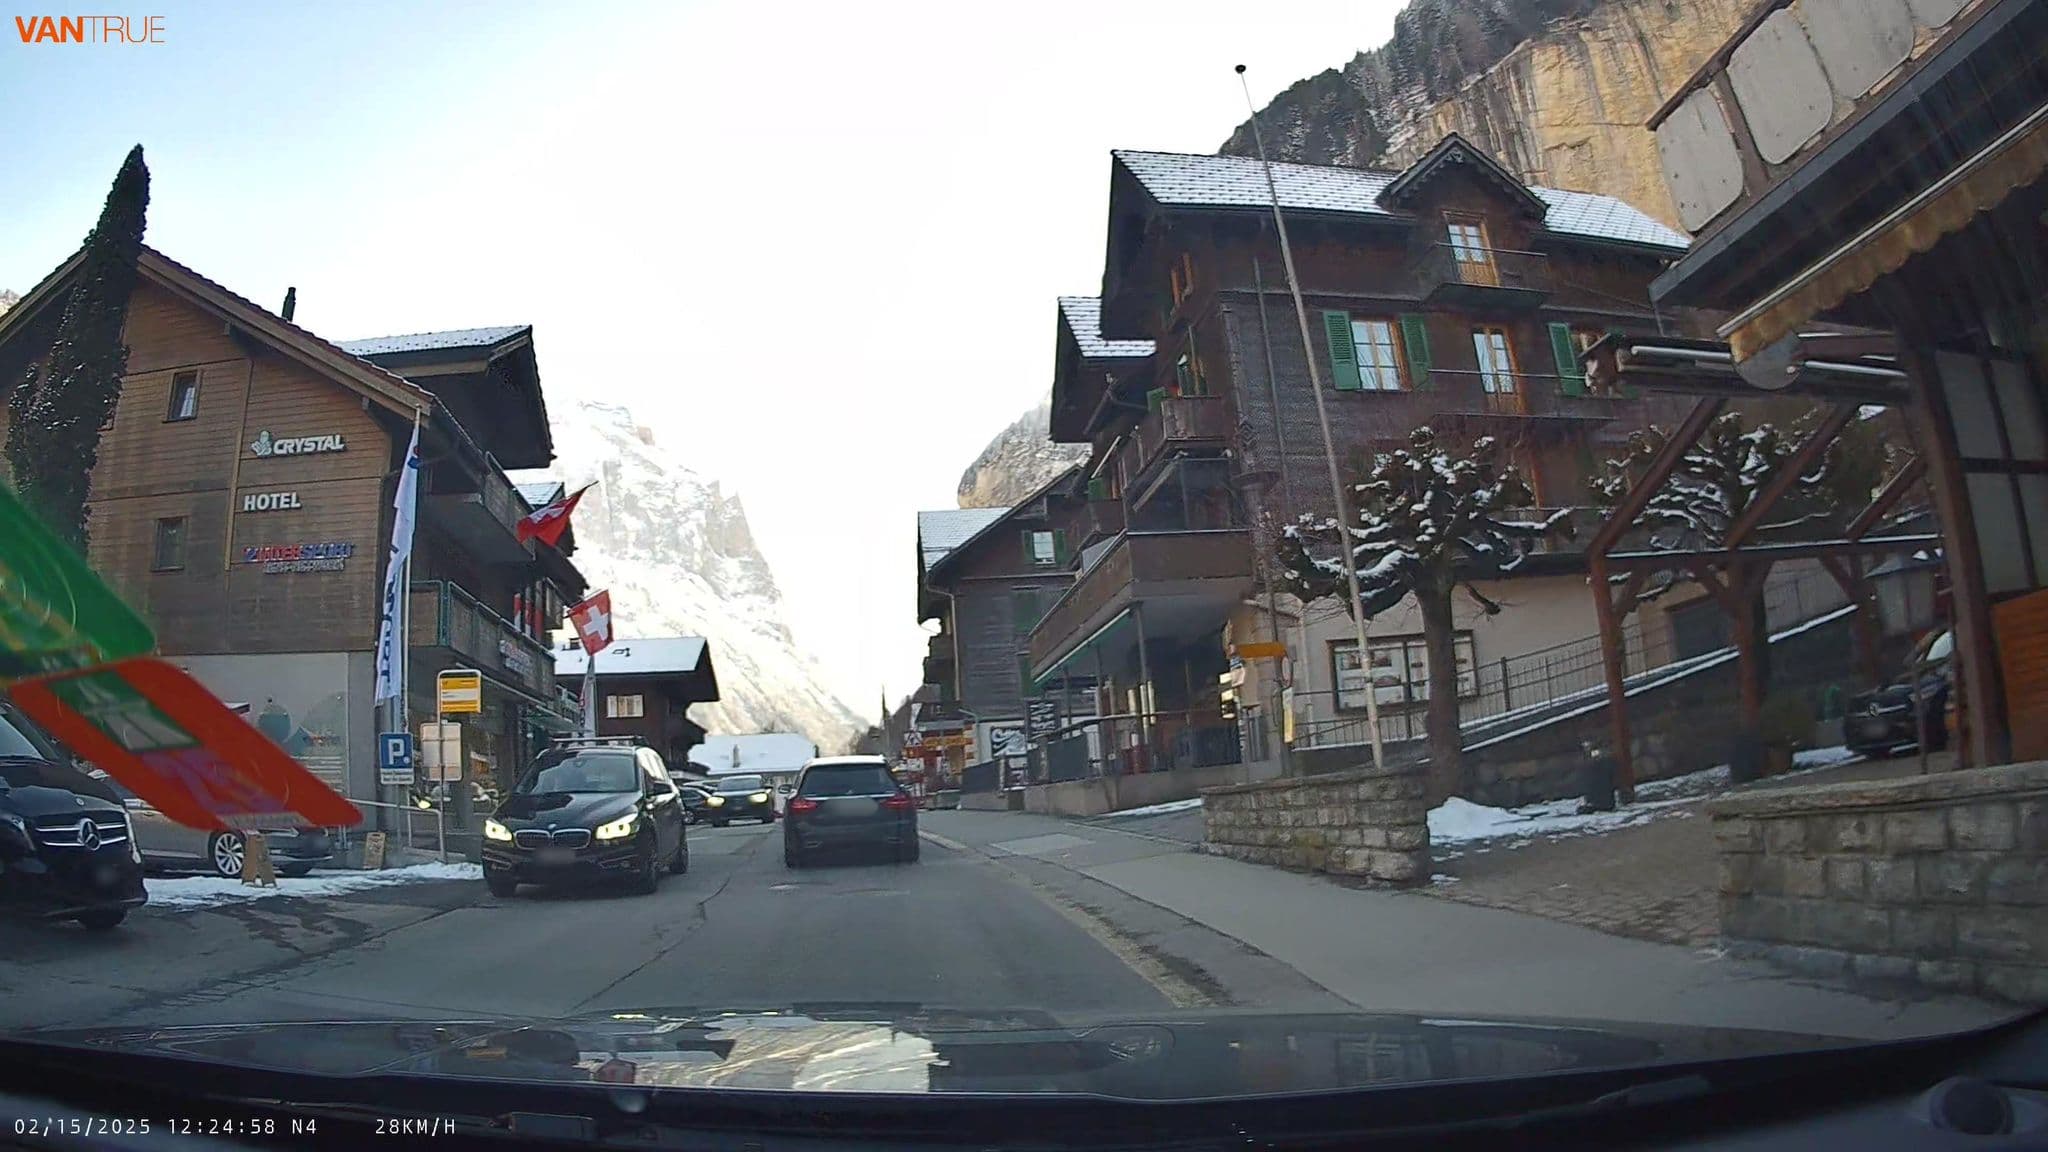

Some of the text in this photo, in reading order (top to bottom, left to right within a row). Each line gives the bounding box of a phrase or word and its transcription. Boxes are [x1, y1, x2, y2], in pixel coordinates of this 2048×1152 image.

[272, 433, 345, 456] CRYSTAL
[243, 490, 302, 512] HOTEL
[387, 738, 405, 765] P
